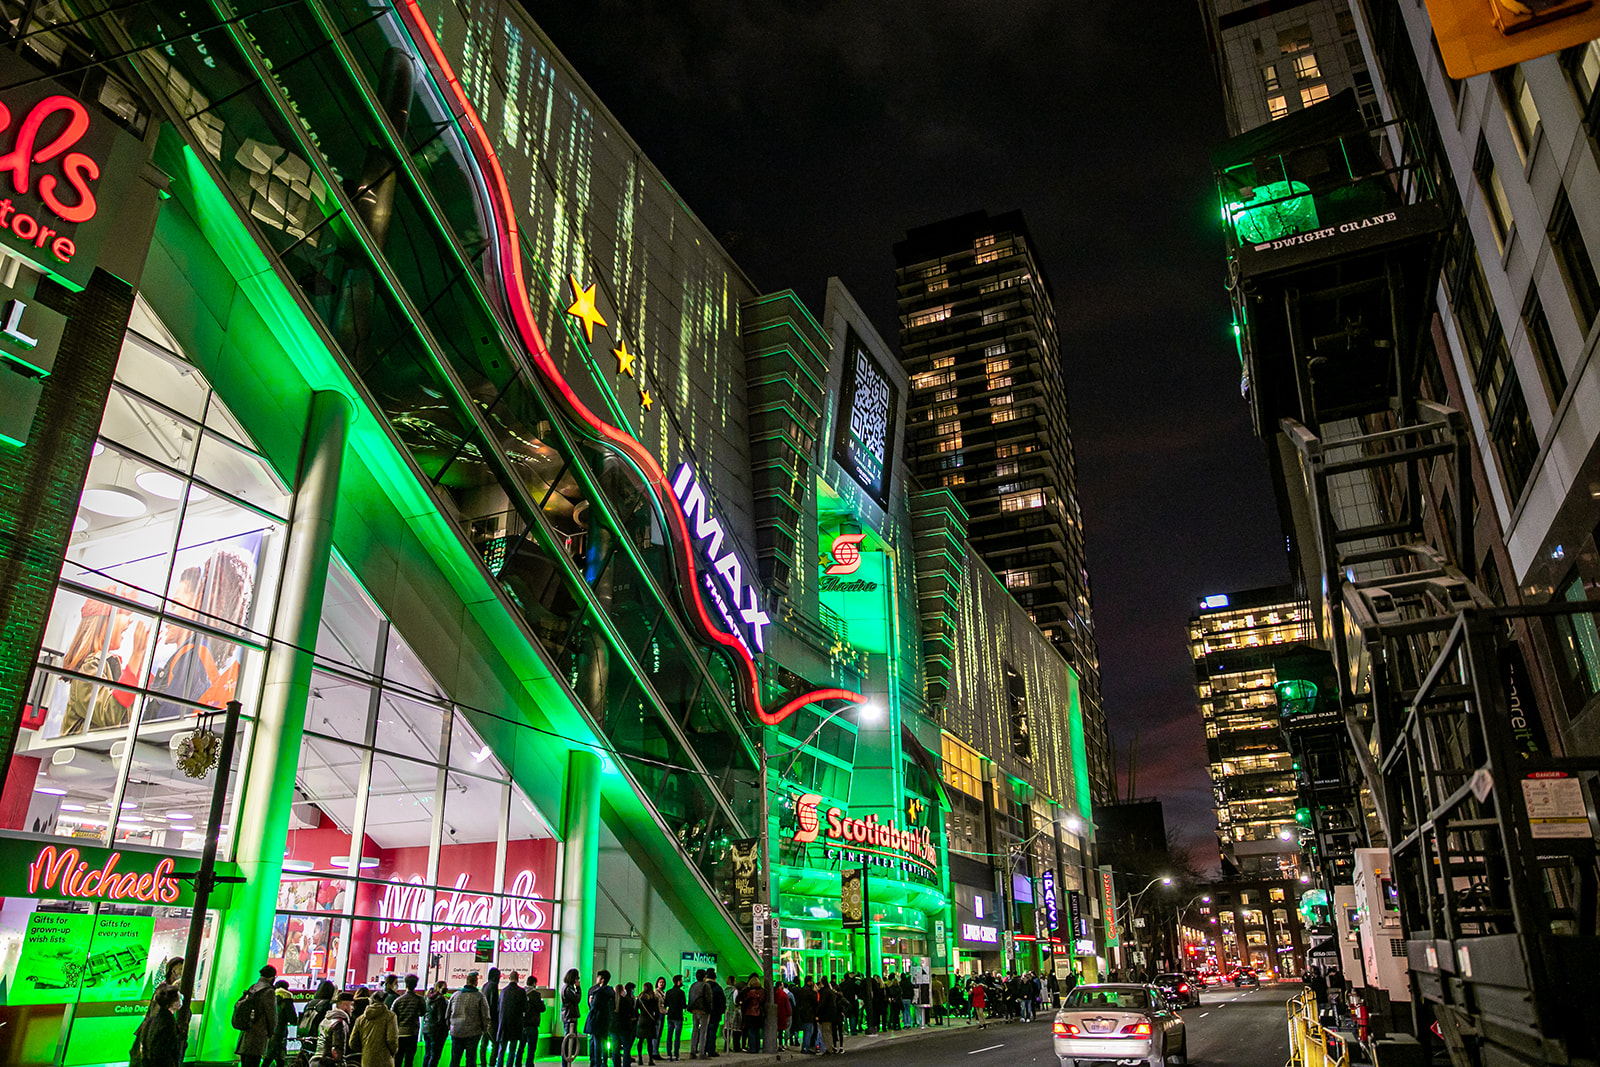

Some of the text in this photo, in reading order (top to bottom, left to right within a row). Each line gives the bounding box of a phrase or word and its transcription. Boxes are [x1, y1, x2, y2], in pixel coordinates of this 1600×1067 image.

[1272, 212, 1397, 250] DWIGHT CRANE
[673, 461, 771, 653] IMAX
[827, 807, 921, 857] Scotiabank
[827, 849, 894, 869] CINEPLEX
[28, 845, 180, 903] Michaels
[1103, 873, 1112, 906] FITNESS
[378, 870, 546, 935] Mchals
[34, 915, 68, 924] Gifts for
[100, 920, 131, 928] Gifts for
[31, 927, 71, 935] grown-up
[376, 937, 400, 954] the
[400, 939, 421, 954] art
[429, 936, 455, 954] and
[502, 936, 542, 953] store
[693, 953, 715, 964] Notice
[114, 1005, 133, 1013] Cake
